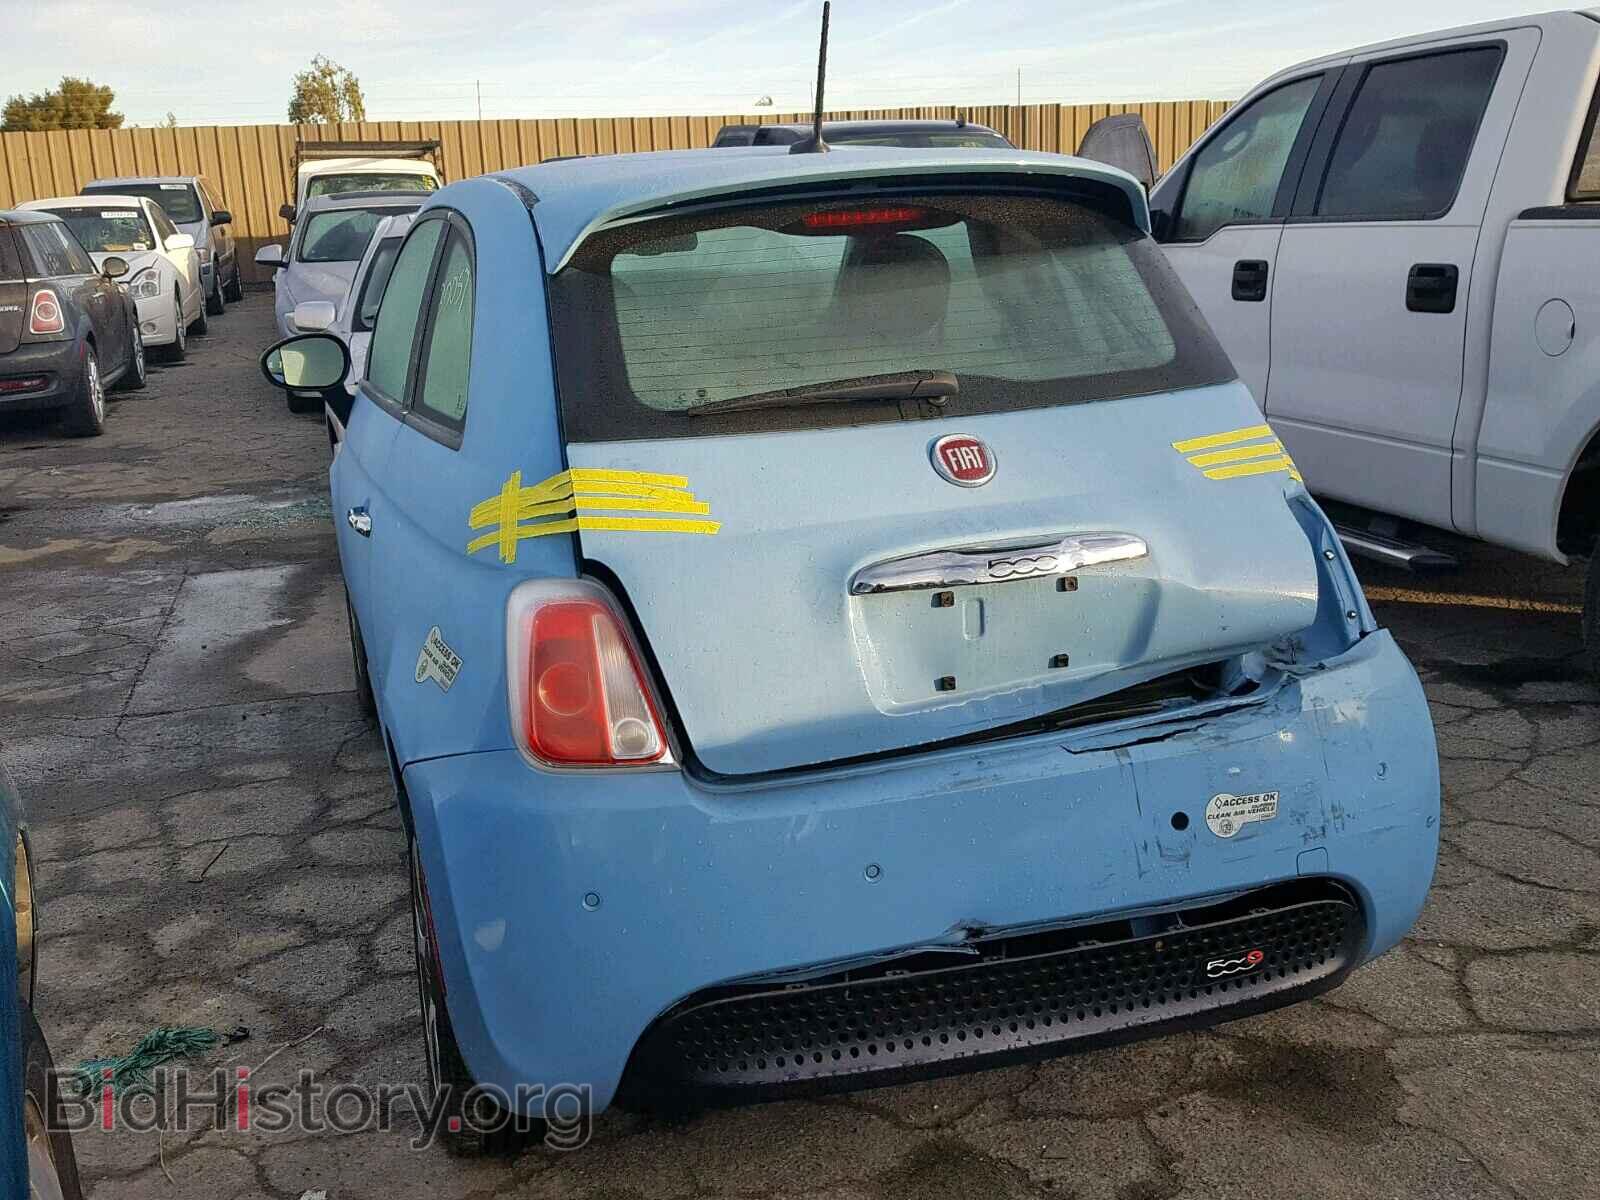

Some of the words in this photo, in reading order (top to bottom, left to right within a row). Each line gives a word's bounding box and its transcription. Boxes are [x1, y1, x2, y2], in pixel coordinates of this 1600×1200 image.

[945, 445, 983, 473] FIAT
[988, 555, 1058, 579] 500
[1223, 795, 1260, 807] ACCESS
[1263, 793, 1276, 802] OK
[1207, 811, 1231, 820] CLEAN
